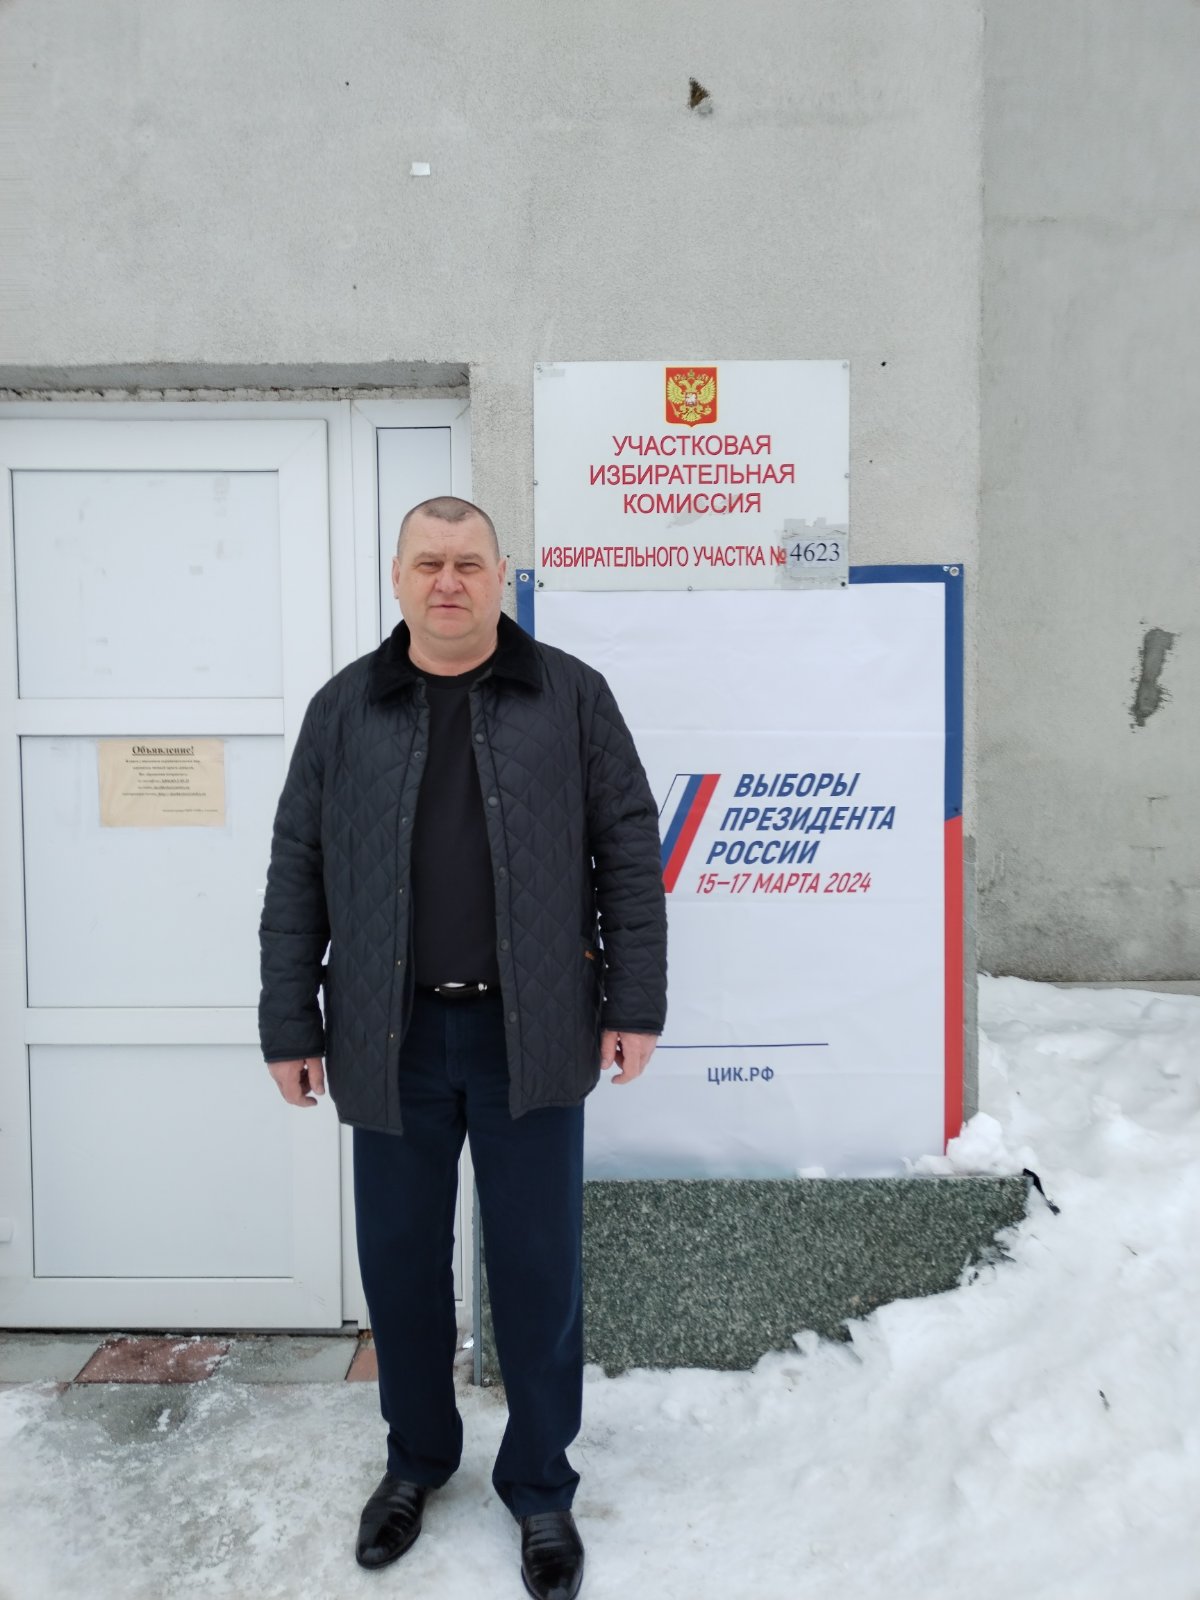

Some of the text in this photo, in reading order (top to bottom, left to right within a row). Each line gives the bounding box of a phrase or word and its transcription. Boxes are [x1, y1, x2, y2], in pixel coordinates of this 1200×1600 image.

[612, 434, 771, 456] УЧАСТКОВАЯ
[589, 464, 795, 485] ИЗБИРАТЕЛЬНАЯ
[623, 492, 761, 514] КОМИССИЯ
[541, 546, 689, 567] ИЗБИРАТЕЛЬНОГО
[693, 545, 765, 566] УЧАСТКА
[789, 542, 840, 562] 4623
[132, 745, 194, 756] Объявление!
[734, 773, 861, 797] ВЫБОРЫ
[720, 806, 896, 834] ПРЕЗИДЕНТА
[706, 840, 820, 865] РОССИИ
[752, 873, 821, 893] МАРТА
[823, 872, 872, 893] 2024
[708, 1066, 775, 1085] ЦИК.РФ
